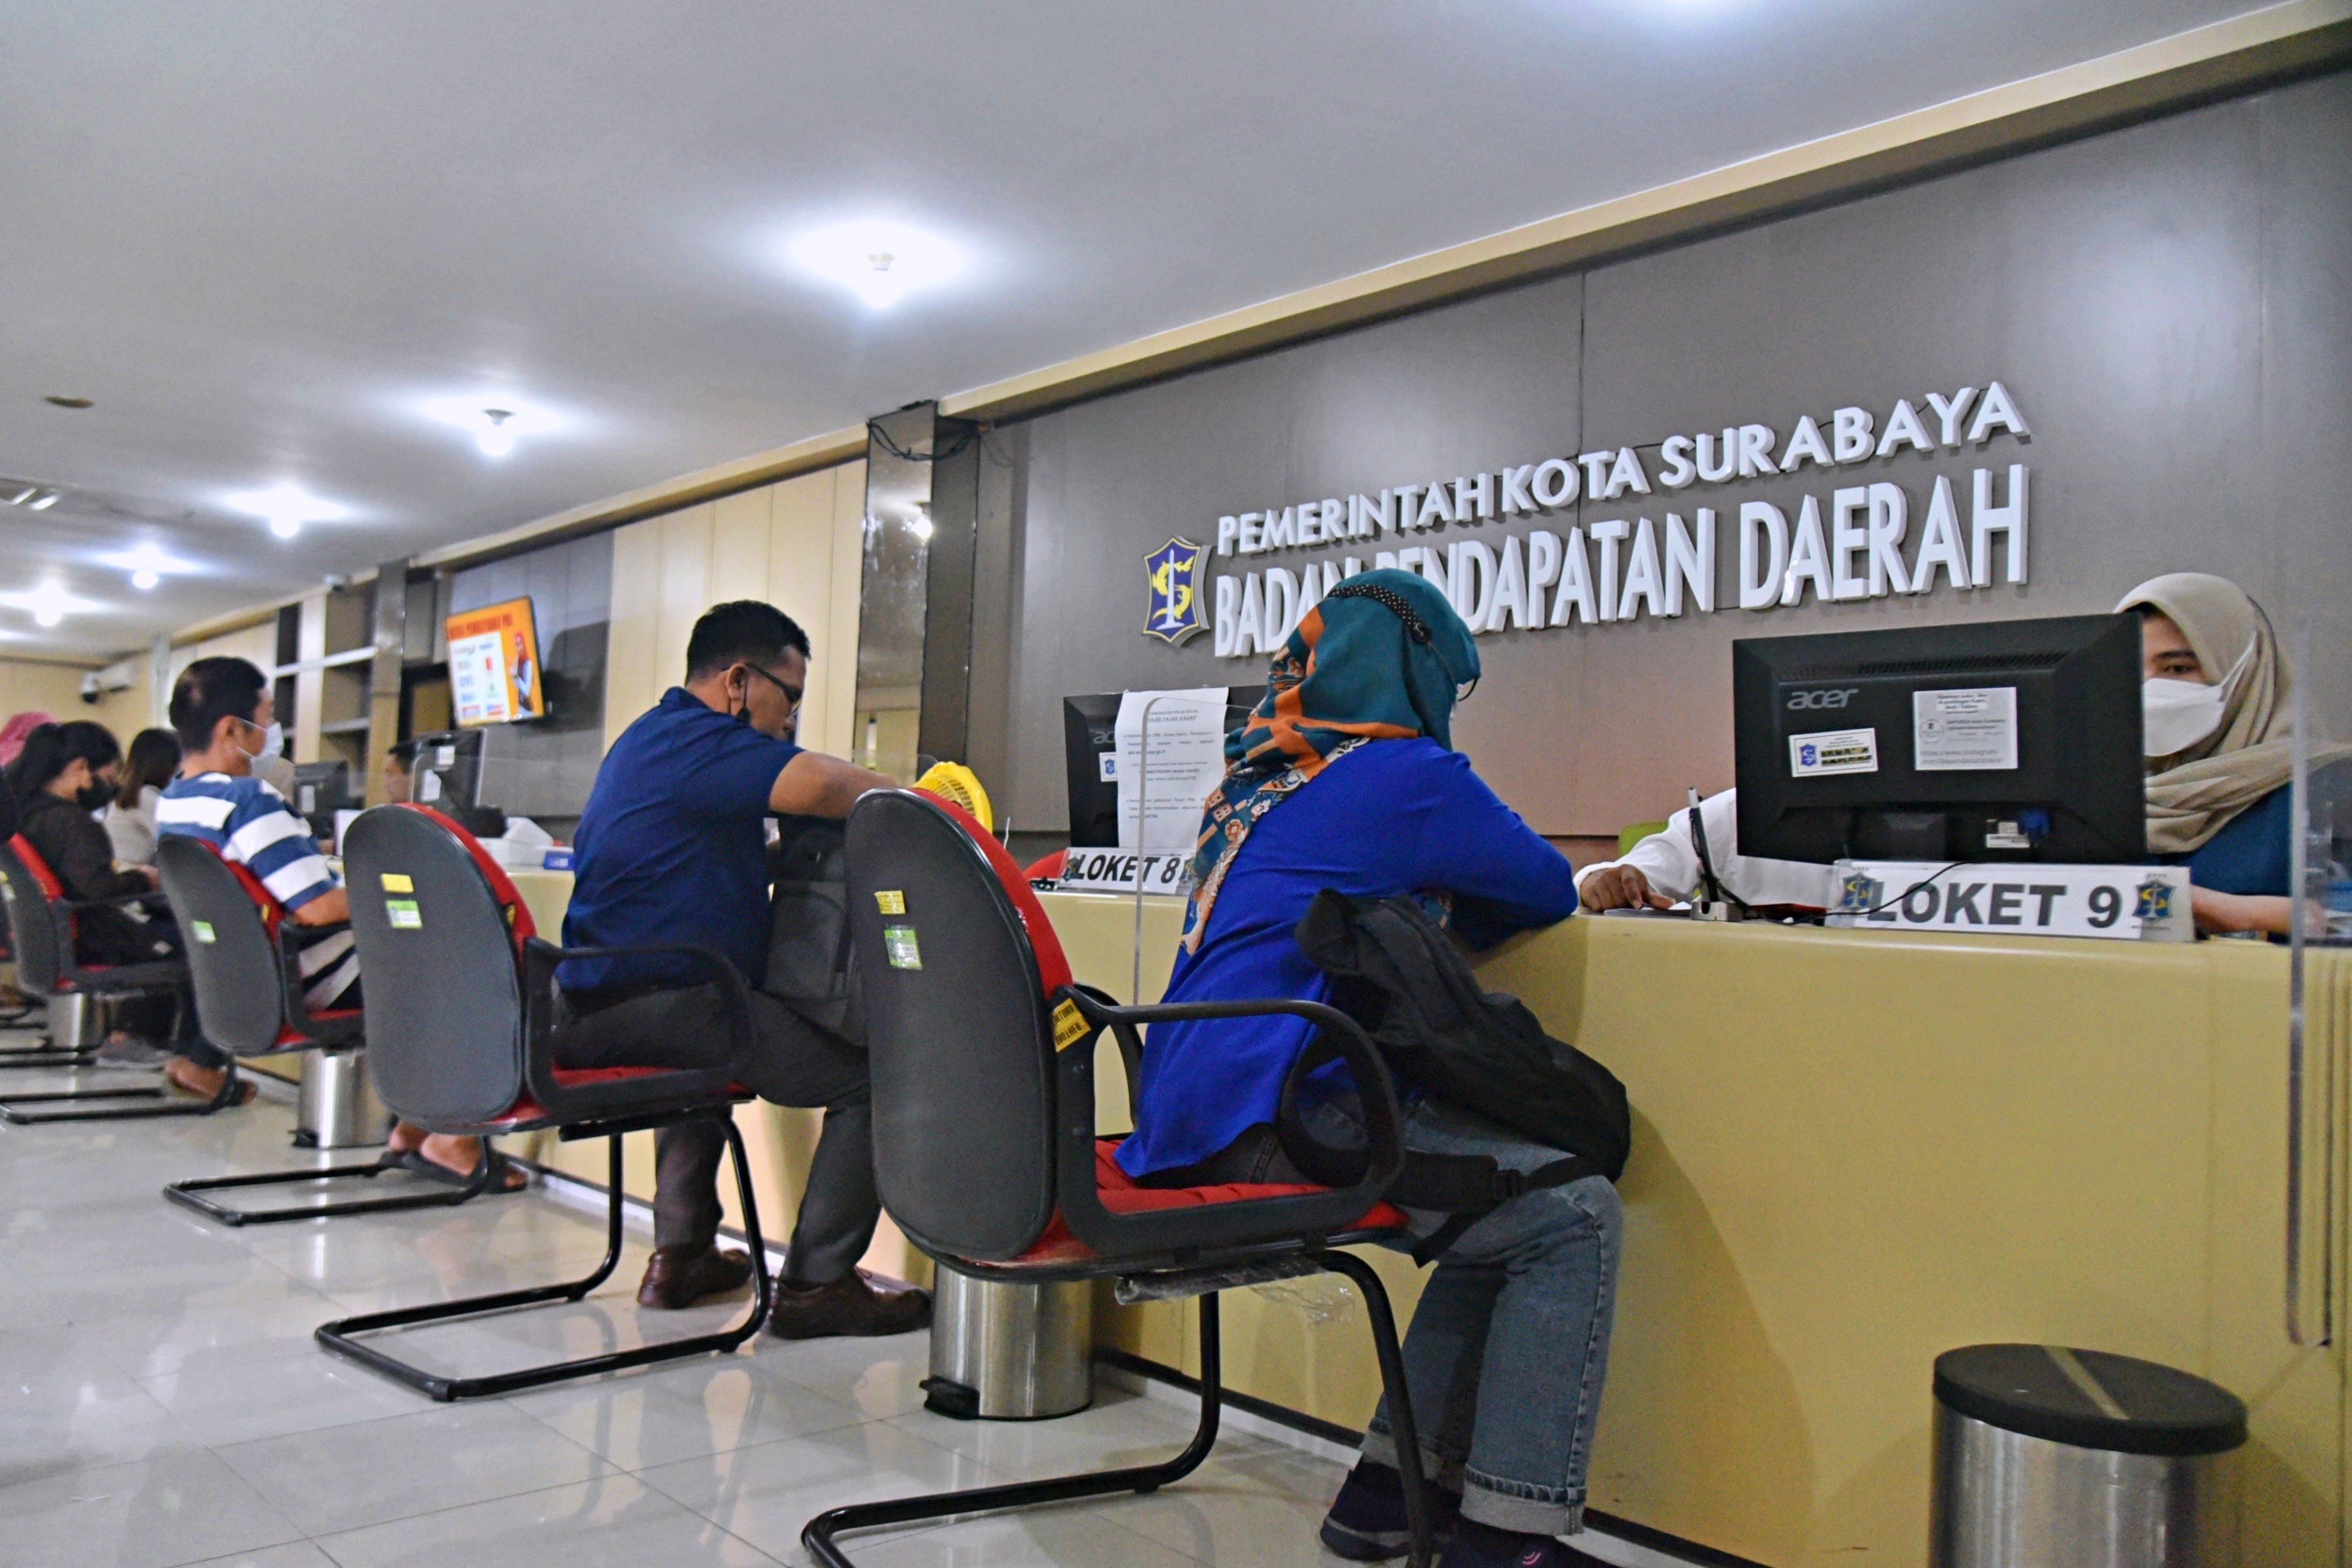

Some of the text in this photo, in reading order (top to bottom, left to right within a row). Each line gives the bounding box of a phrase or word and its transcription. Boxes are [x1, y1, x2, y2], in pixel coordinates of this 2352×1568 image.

[1217, 380, 2032, 557] PEMERINTAH KOTA SURABAYA
[1214, 556, 1363, 658] BADA
[1739, 464, 2030, 610] DAERAH
[1787, 688, 1860, 710] acer
[1073, 853, 1181, 884] LOKET 8
[1868, 881, 2123, 929] LOKET 9
